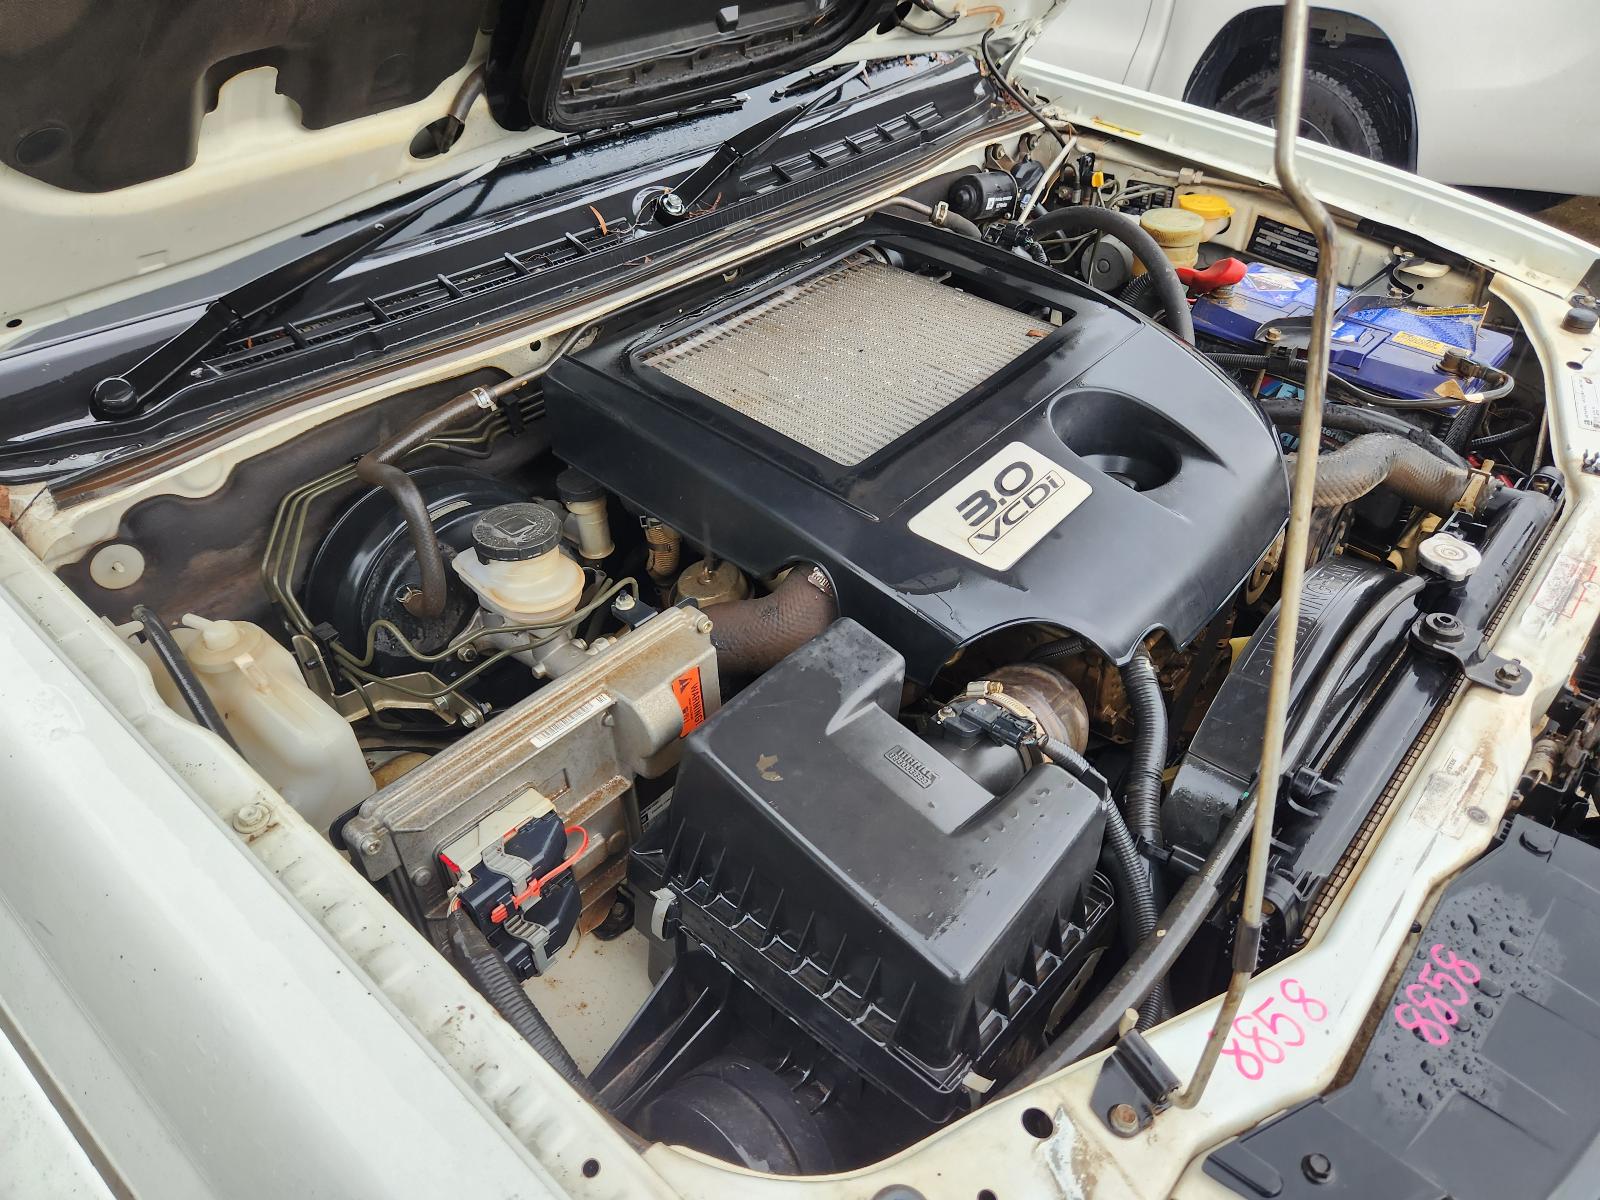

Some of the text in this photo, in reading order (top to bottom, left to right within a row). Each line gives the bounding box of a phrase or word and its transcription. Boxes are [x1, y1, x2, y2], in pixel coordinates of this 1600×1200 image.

[956, 461, 1034, 526] 3.0
[972, 475, 1060, 542] VCDi
[1208, 978, 1328, 1080] 8858
[1395, 944, 1481, 1046] 8858
